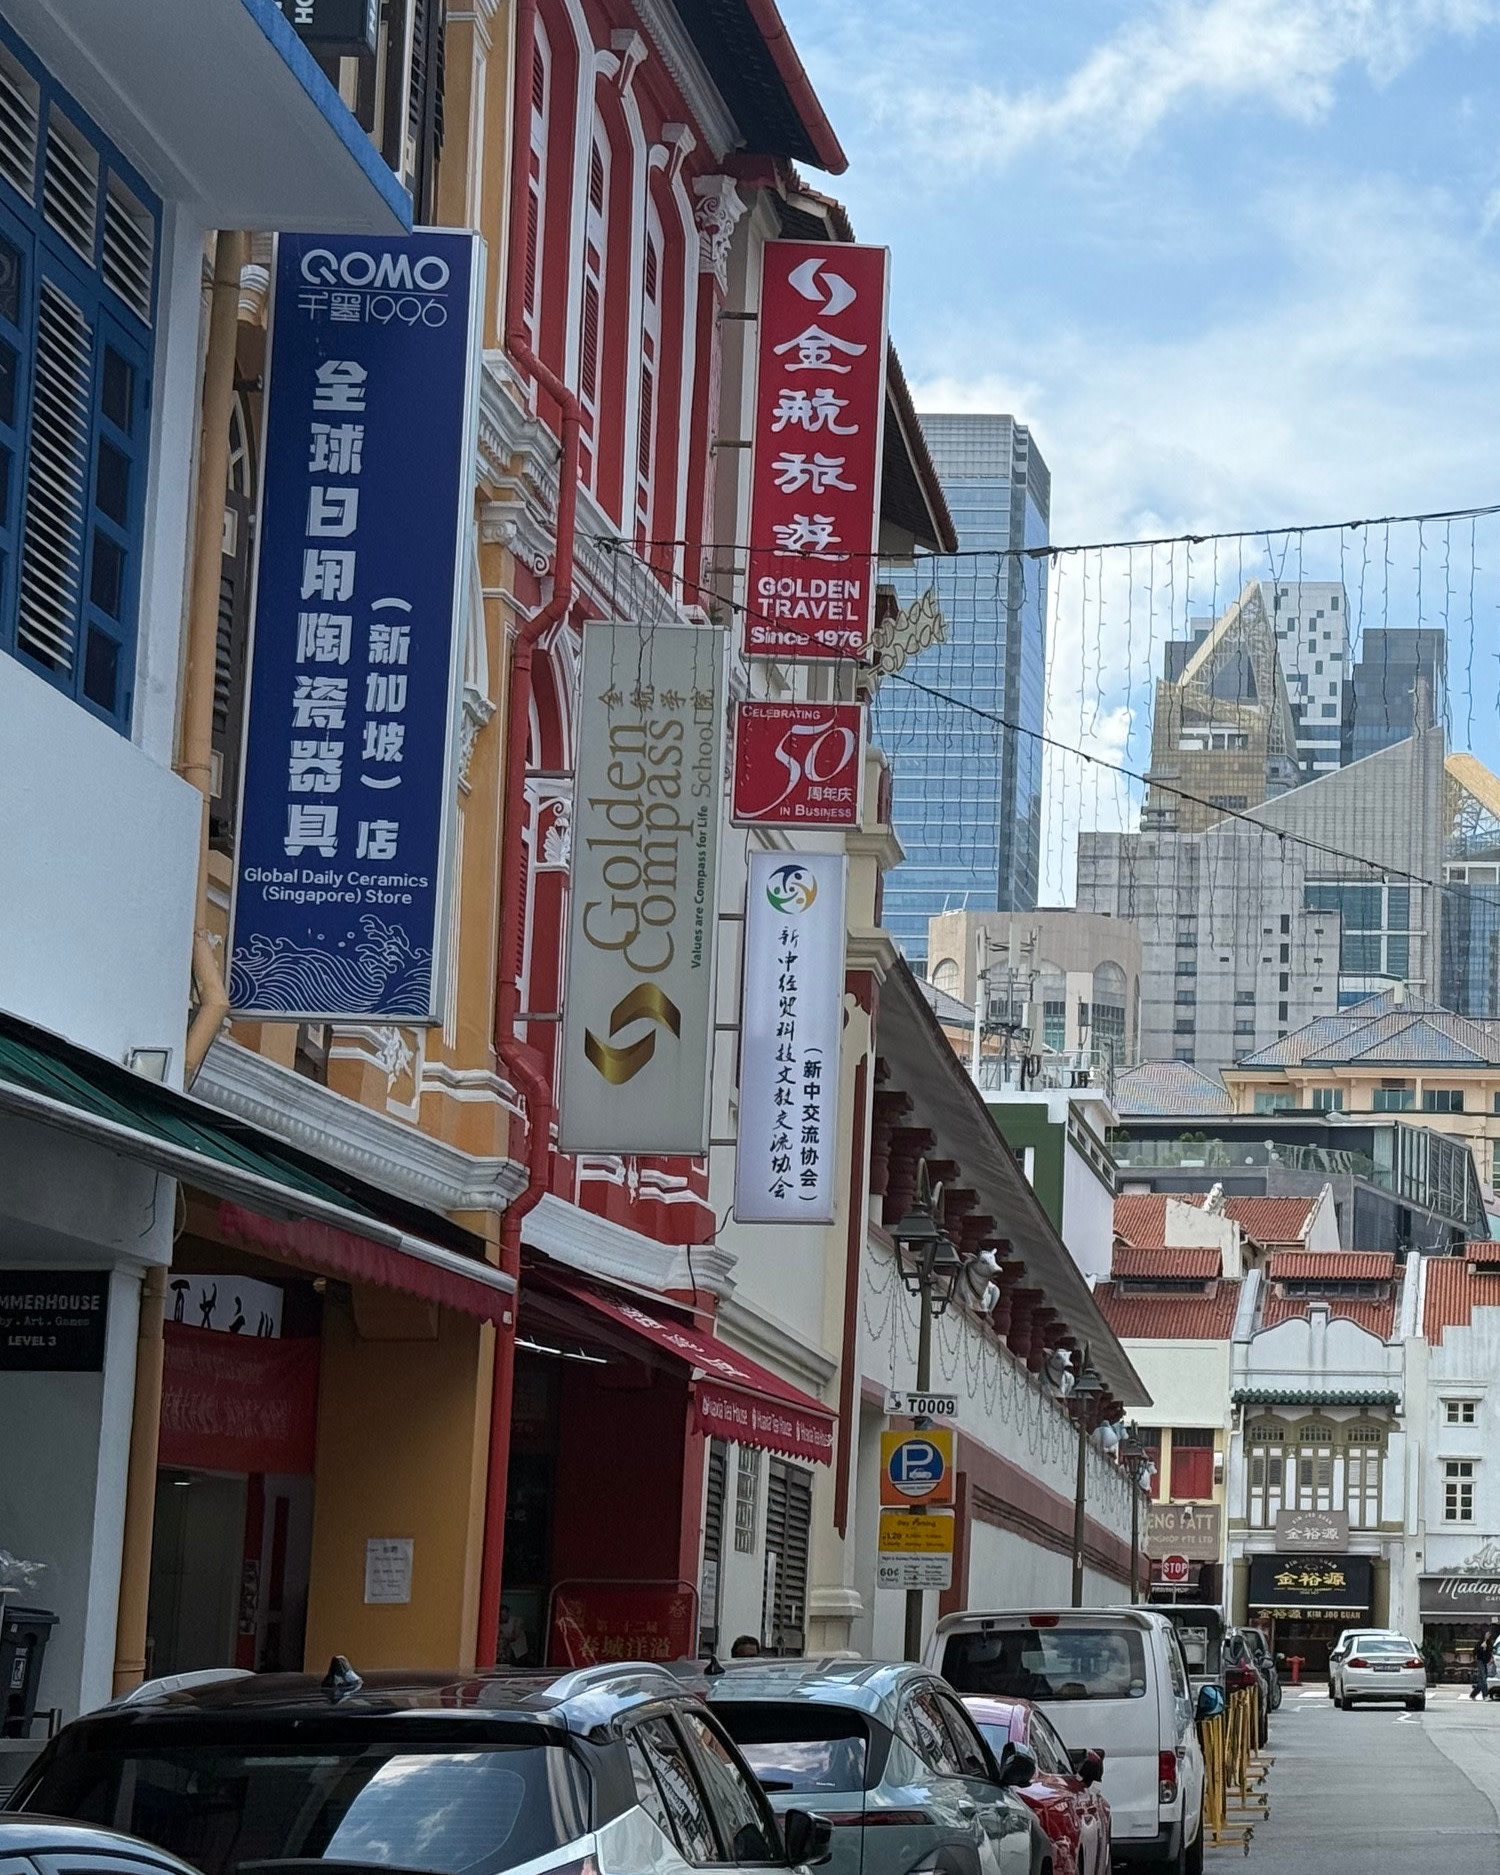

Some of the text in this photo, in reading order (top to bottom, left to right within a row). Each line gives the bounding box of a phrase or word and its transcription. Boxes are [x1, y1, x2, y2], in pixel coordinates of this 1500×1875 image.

[300, 248, 450, 291] QOMO
[757, 576, 860, 600] GOLDEN
[284, 359, 368, 858] 全球日用陶瓷器具
[757, 597, 859, 622] TRAVEL
[751, 624, 863, 648] Since 1976
[690, 719, 715, 798] School
[736, 707, 857, 818] 50
[807, 786, 853, 803] 周年庆
[582, 719, 648, 951] Golden
[622, 718, 695, 974] Compass
[244, 868, 429, 888] Global Daily Ceramics
[691, 805, 709, 969] Values are Compass for Life
[262, 885, 412, 905] (Singapore) Store
[798, 1047, 824, 1202] （新中交流协会）
[8, 1335, 57, 1347] LEVEL 3
[908, 1399, 955, 1415] T0009
[902, 1444, 934, 1481] P
[1284, 1527, 1340, 1541] 金裕源
[1163, 1562, 1188, 1574] STOP
[1273, 1571, 1347, 1587] 金裕源
[1257, 1608, 1303, 1620] 金裕源
[1306, 1610, 1322, 1619] KIM
